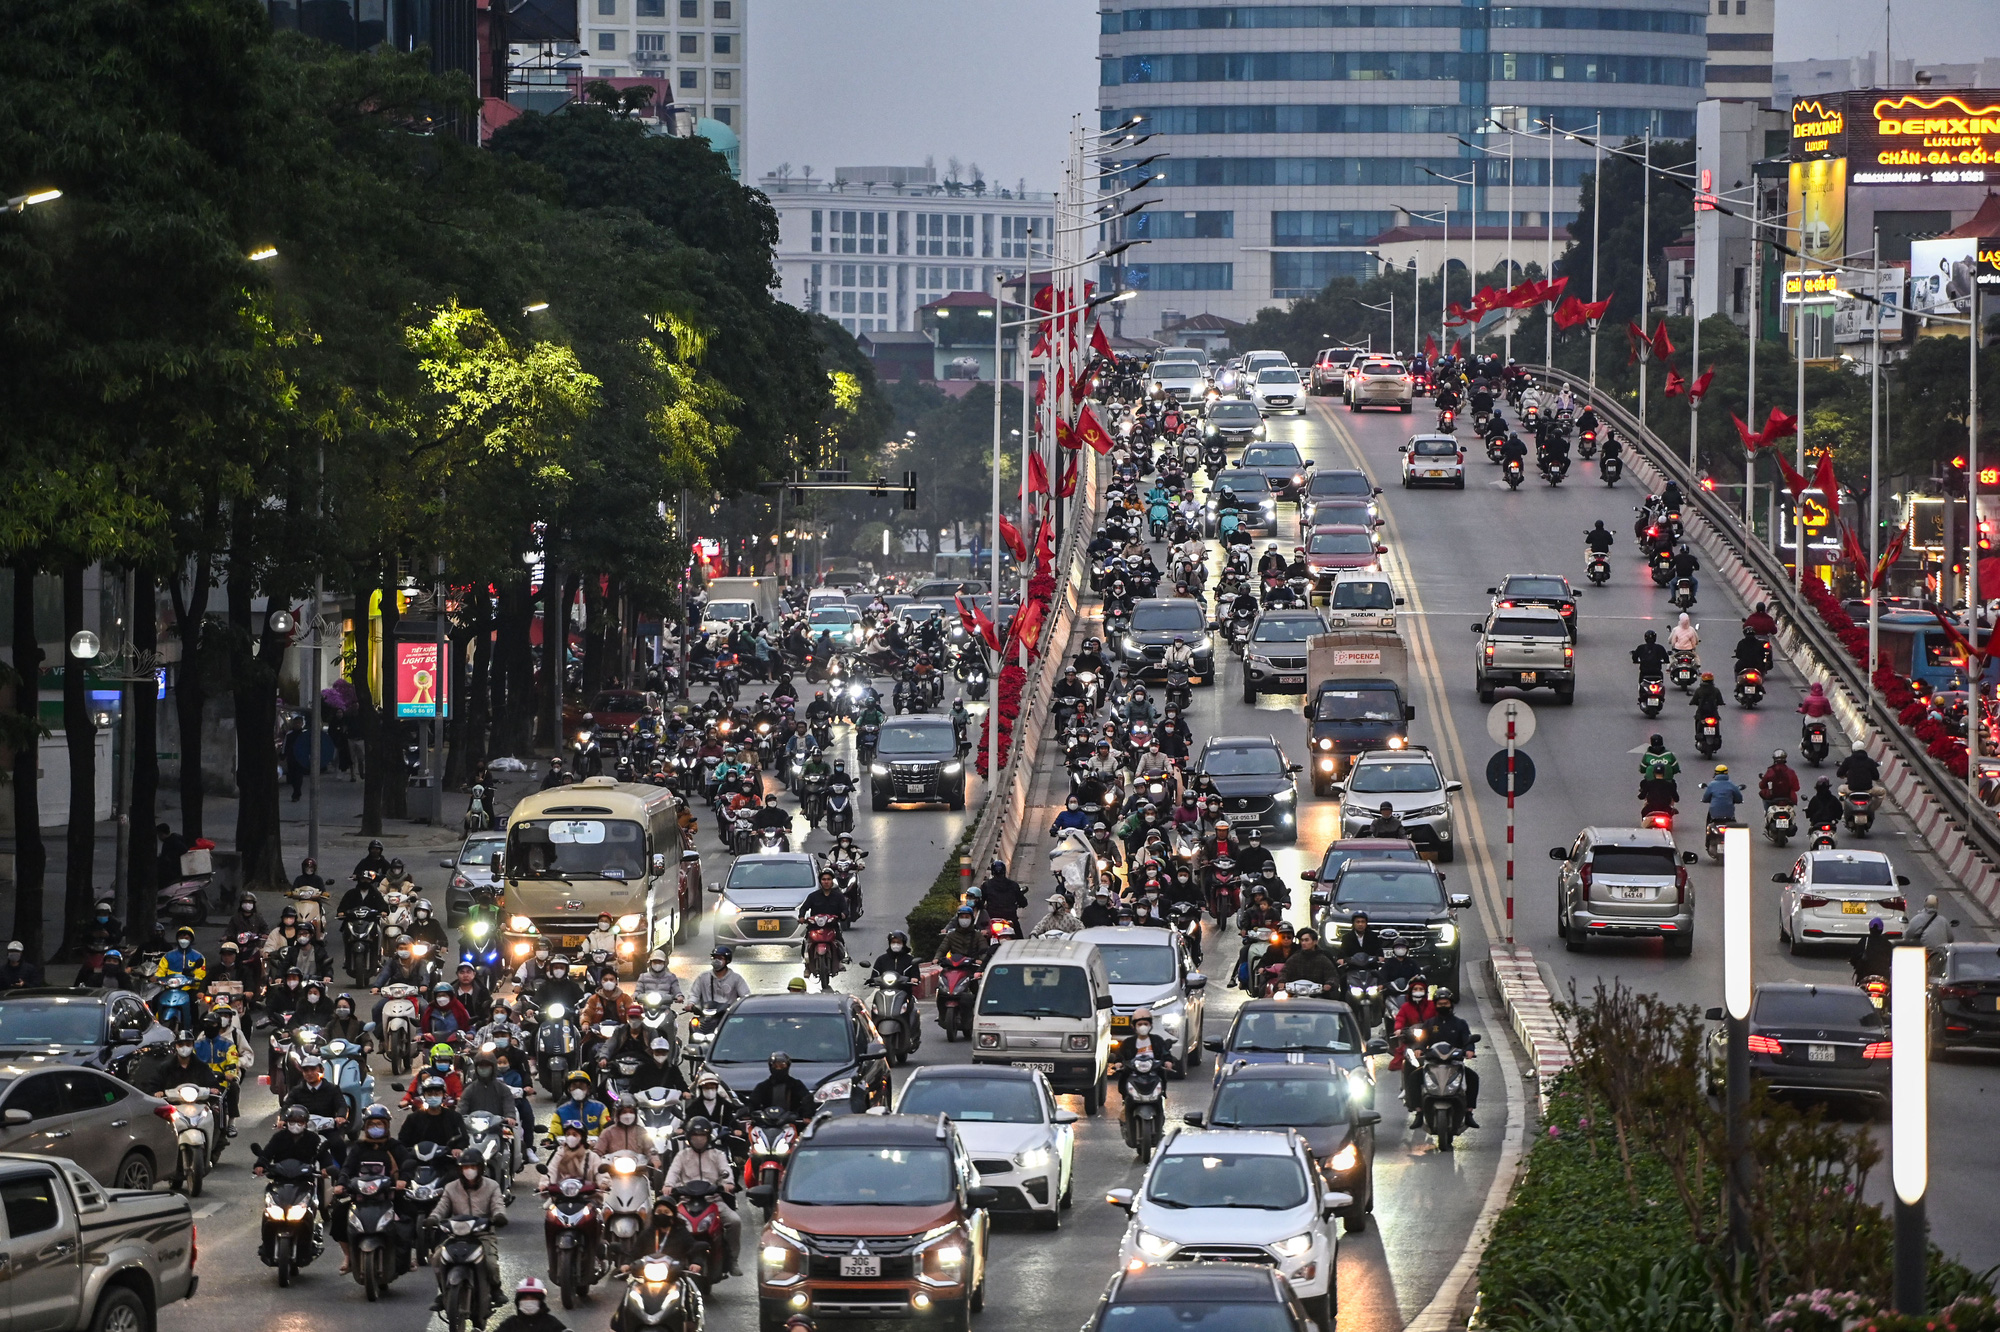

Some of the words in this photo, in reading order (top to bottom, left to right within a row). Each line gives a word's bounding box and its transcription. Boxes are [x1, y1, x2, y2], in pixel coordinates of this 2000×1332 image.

[1793, 119, 1842, 138] DEMXINH
[1923, 136, 1981, 147] LUXURY
[1980, 469, 1998, 484] 69
[851, 1257, 870, 1266] 30G
